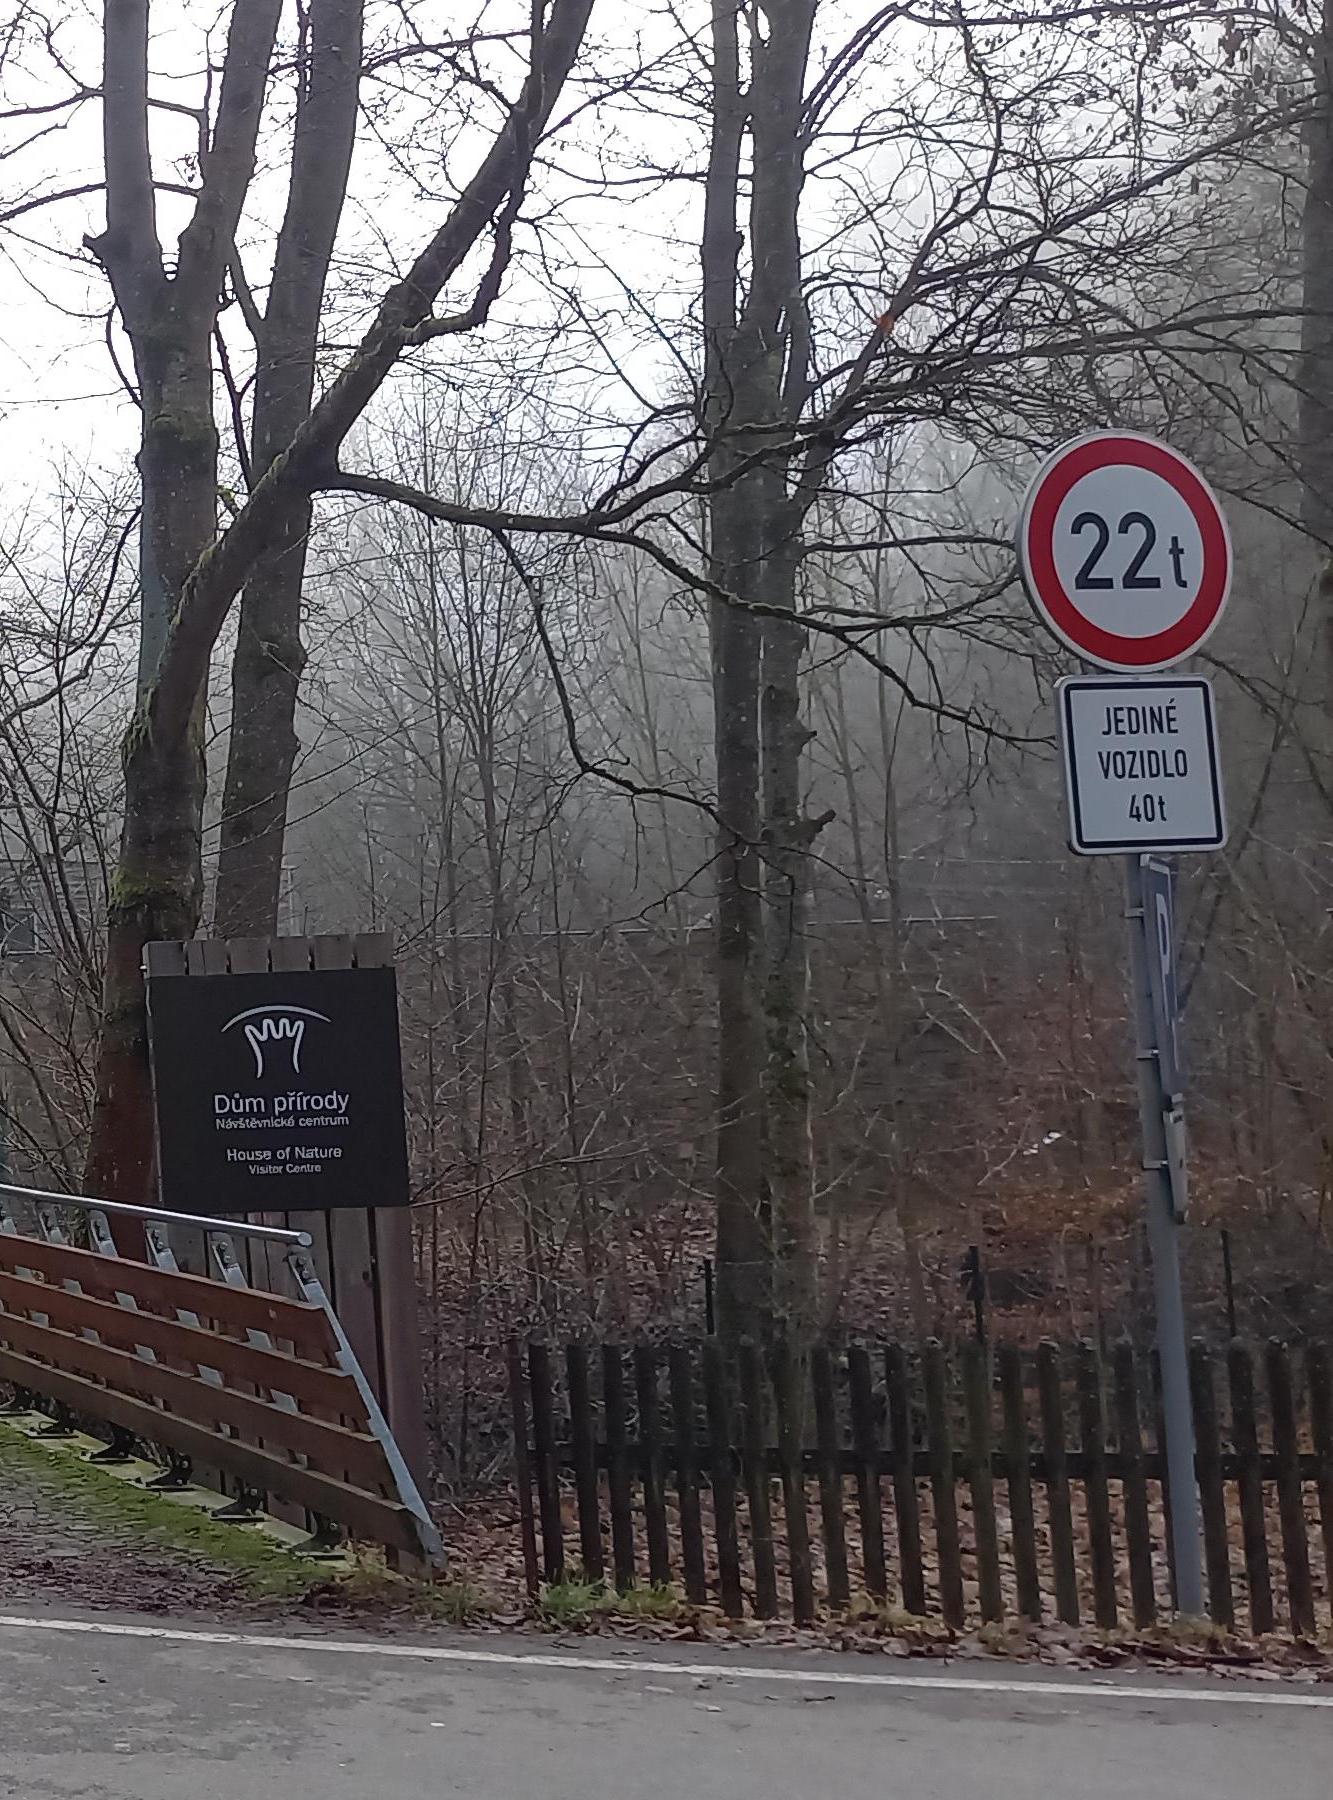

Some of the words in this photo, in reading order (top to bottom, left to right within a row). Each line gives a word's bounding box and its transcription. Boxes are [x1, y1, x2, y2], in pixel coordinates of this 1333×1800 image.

[1101, 697, 1179, 736] JEDINÉ
[1097, 748, 1189, 780] VOZIDLO
[214, 1092, 266, 1114] Dům
[273, 1090, 350, 1117] přírody
[215, 1115, 295, 1130] Návštěvnické
[298, 1116, 350, 1127] centrum
[226, 1148, 272, 1162] House
[276, 1146, 291, 1161] of
[294, 1146, 343, 1159] Nature
[248, 1163, 284, 1175] Visitor
[285, 1163, 322, 1174] Centre
